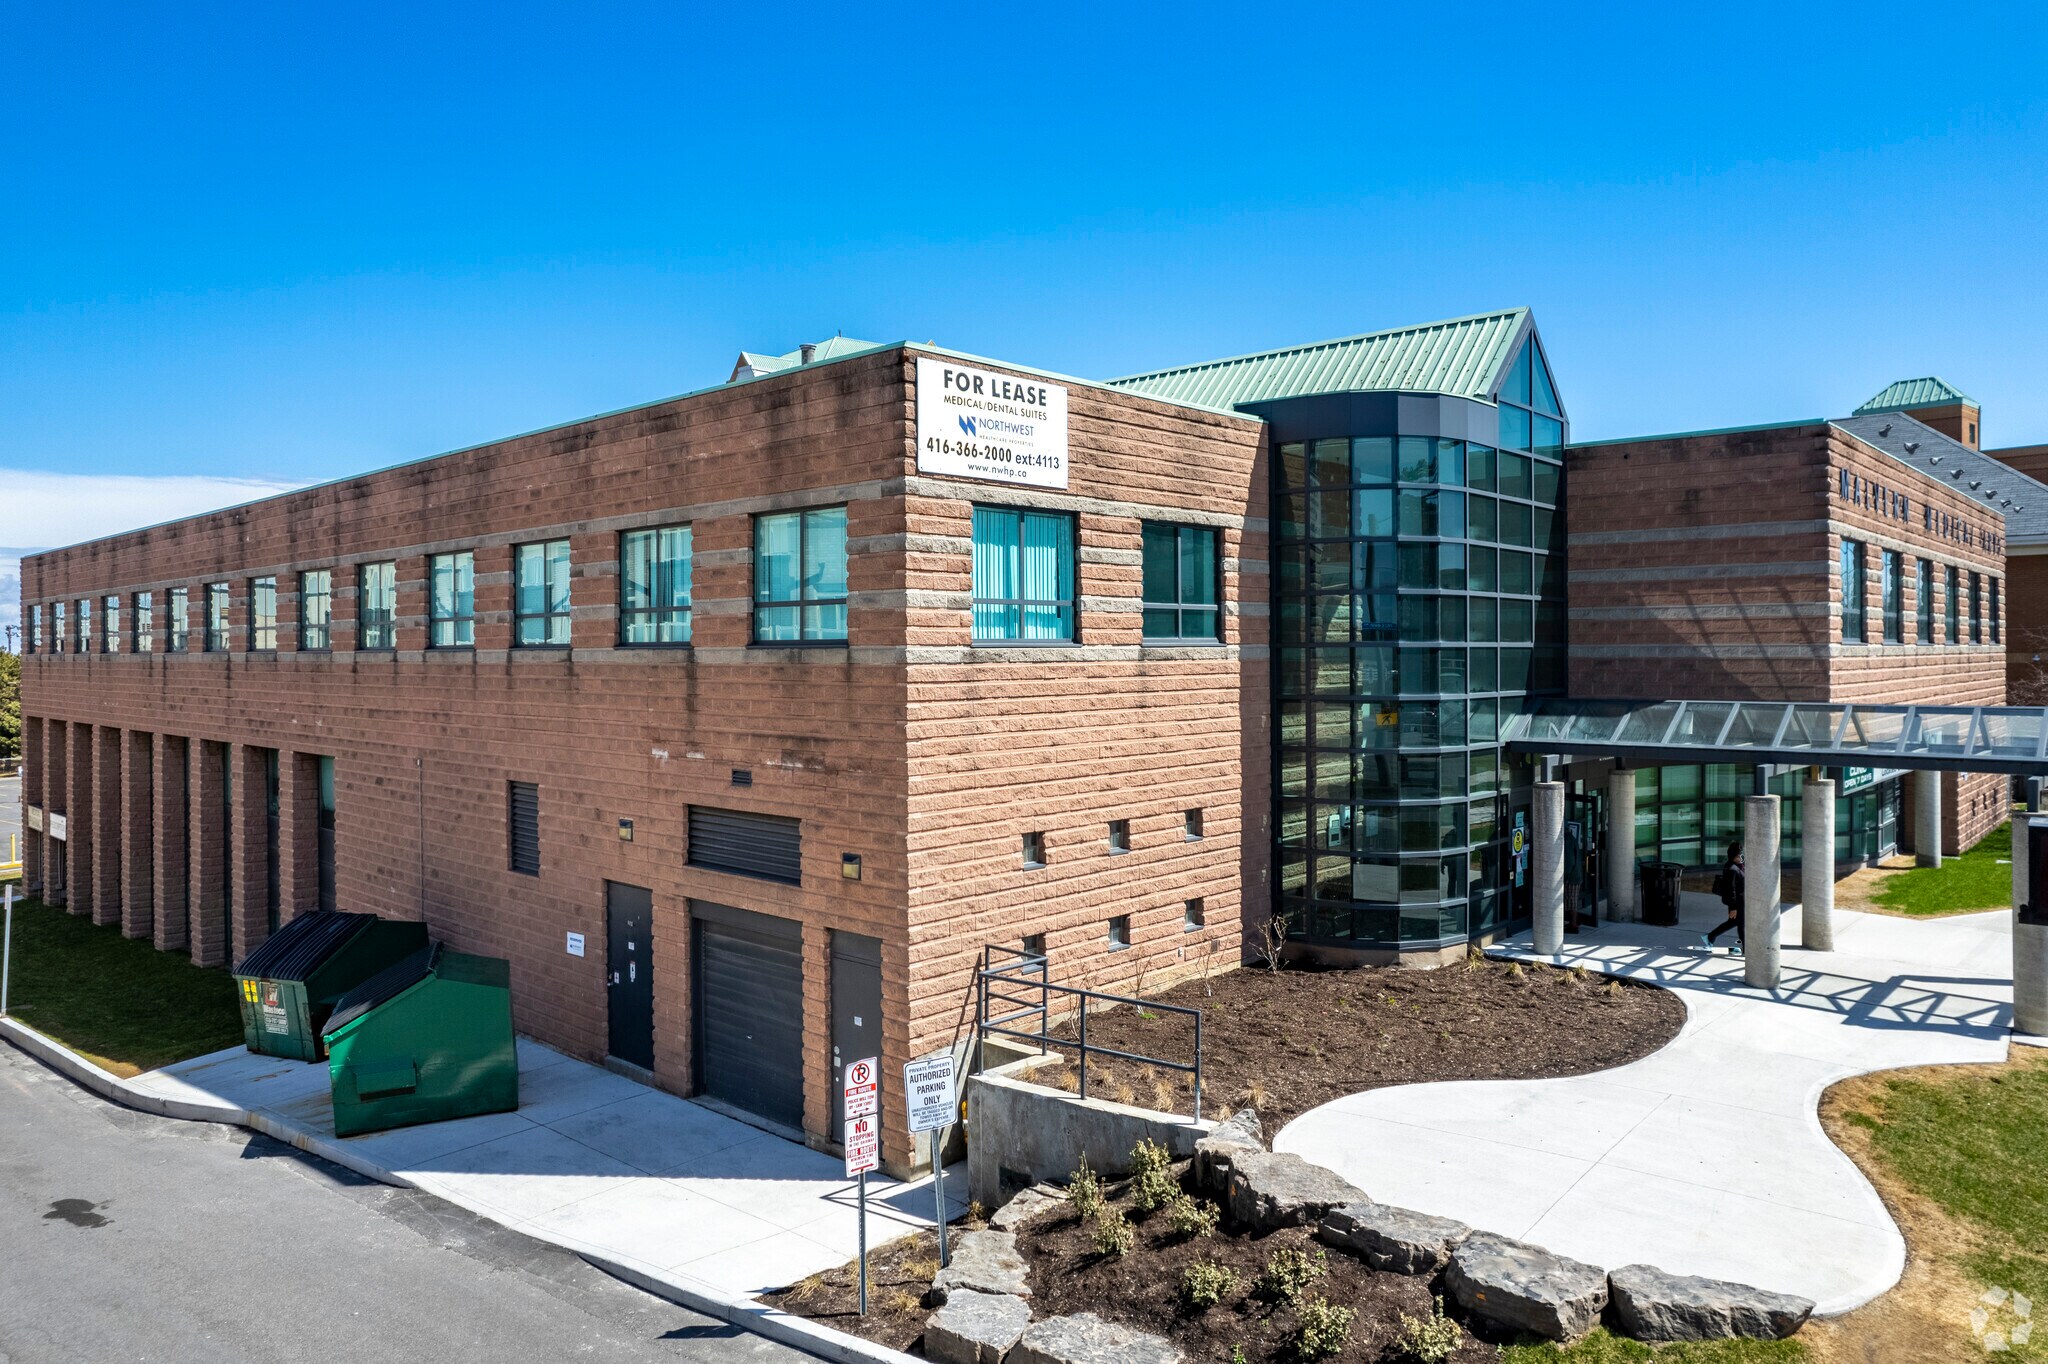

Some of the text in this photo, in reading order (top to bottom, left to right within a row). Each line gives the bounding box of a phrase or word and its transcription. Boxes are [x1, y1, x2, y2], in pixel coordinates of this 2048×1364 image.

[944, 369, 1047, 406] FOR LEASE
[944, 395, 1047, 421] MEDICAL/DENTAL SUITES
[979, 418, 1035, 437] NORTHWEST
[979, 435, 1034, 447] HEALTHCARE PROPERTIES
[927, 437, 1060, 469] 416-366-2000 ext:4113
[968, 463, 1027, 478] www.nwhp.ca
[1840, 468, 1909, 525] MALVERN
[1924, 504, 1973, 547] MEDICAL
[1844, 778, 1856, 788] OPEN
[1860, 772, 1872, 783] DAYS
[928, 1062, 950, 1070] PROPERTY
[910, 1068, 950, 1084] AUTHORIZED
[848, 1084, 872, 1096] FIRE ROUTE
[917, 1081, 945, 1095] PARKING
[924, 1095, 940, 1105] ONLY
[855, 1121, 867, 1134] NO
[849, 1131, 874, 1143] STOPPING
[847, 1144, 875, 1158] FIRE ROUTE
